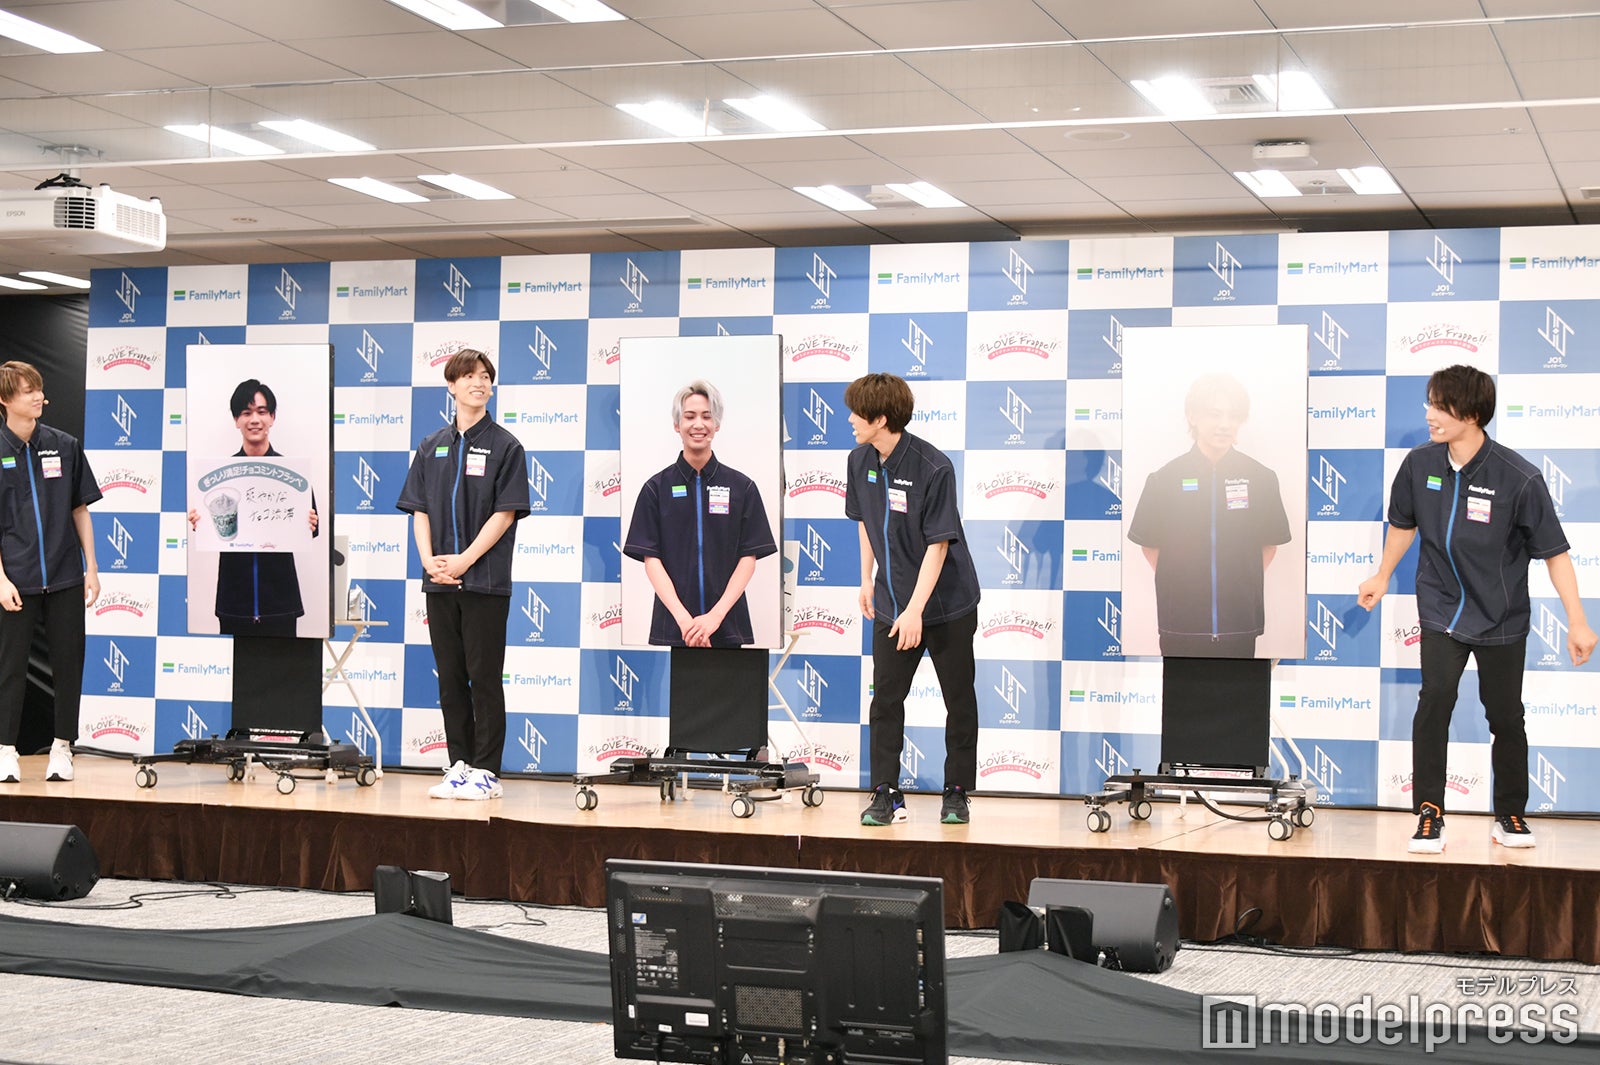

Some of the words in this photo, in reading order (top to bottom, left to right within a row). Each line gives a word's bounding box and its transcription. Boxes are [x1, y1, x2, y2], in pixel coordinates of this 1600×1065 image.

[1308, 262, 1378, 275] FamilyMart
[1532, 256, 1600, 269] FamilyMar
[897, 272, 960, 285] FamilyMart
[1097, 267, 1164, 280] FamilyMart
[525, 282, 582, 294] FamilyMart
[706, 277, 766, 289] FamilyMart
[189, 290, 240, 301] FamilyMart
[353, 286, 408, 298] FamilyMart
[979, 336, 1017, 352] #LOVE
[1019, 336, 1057, 353] Frappe!!
[1400, 329, 1442, 345] #LOVE
[1445, 329, 1487, 347] Frappe!!
[598, 346, 619, 358] #LO
[822, 339, 858, 355] Frappe!!
[350, 414, 403, 425] FamilyMart
[521, 412, 578, 424] FamilyMart
[911, 410, 957, 422] milyMart
[98, 474, 121, 486] LOVE
[595, 477, 621, 489] #LOV
[787, 474, 817, 490] LOVE
[820, 475, 847, 491] Frappe
[1017, 476, 1054, 493] Frappe!!
[518, 544, 575, 556] FamilyMart
[94, 597, 120, 608] LOVE
[817, 611, 852, 628] Frappe!!
[980, 615, 1011, 630] LOVE
[1014, 615, 1052, 633] Frappe!!
[1394, 626, 1420, 638] #LO
[178, 664, 230, 676] FamilyMart
[514, 674, 572, 687] FamilyMart
[1090, 691, 1156, 705] FamilyMart
[1301, 696, 1371, 710] FamilyMart
[117, 719, 147, 733] Frappe!!
[412, 733, 445, 747] #LOVE
[589, 741, 624, 754] #LOVE
[814, 748, 849, 765] Frappe!!
[978, 755, 1009, 769] LOVE
[1012, 755, 1049, 773] Frappe!!
[1446, 773, 1478, 788] rappe!!
